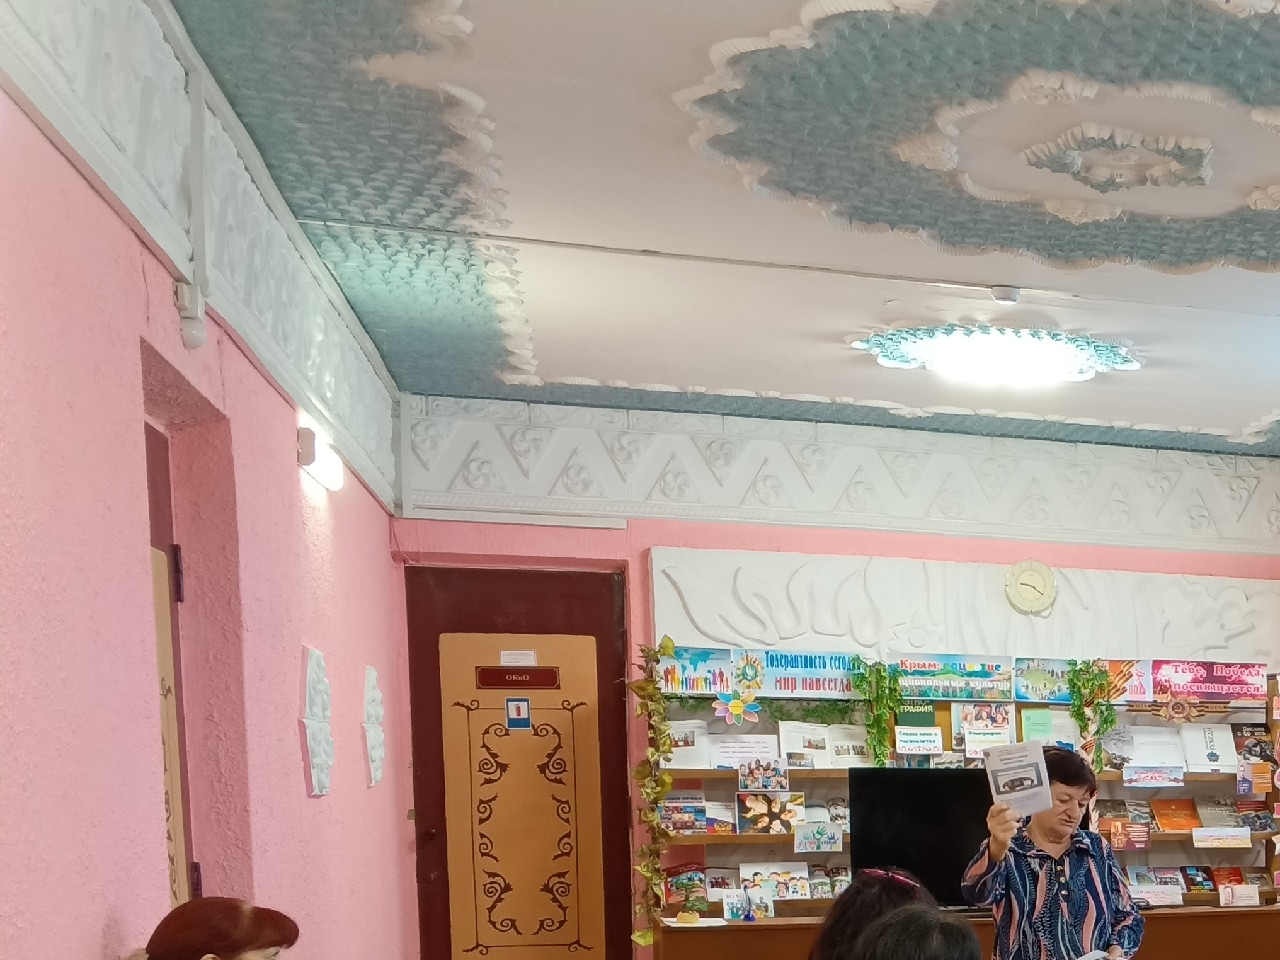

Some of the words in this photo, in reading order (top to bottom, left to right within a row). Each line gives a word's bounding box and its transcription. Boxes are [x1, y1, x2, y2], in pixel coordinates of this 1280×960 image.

[765, 651, 827, 671] Толерантность
[900, 659, 940, 671] Крым:
[943, 662, 1002, 672] соцвтие
[1172, 664, 1207, 678] Тебе,
[1213, 664, 1265, 679] Победа,
[774, 677, 797, 693] мир
[801, 678, 852, 693] навсегда
[1173, 682, 1265, 694] посвящается!
[900, 705, 934, 713] ГРАФИЯ
